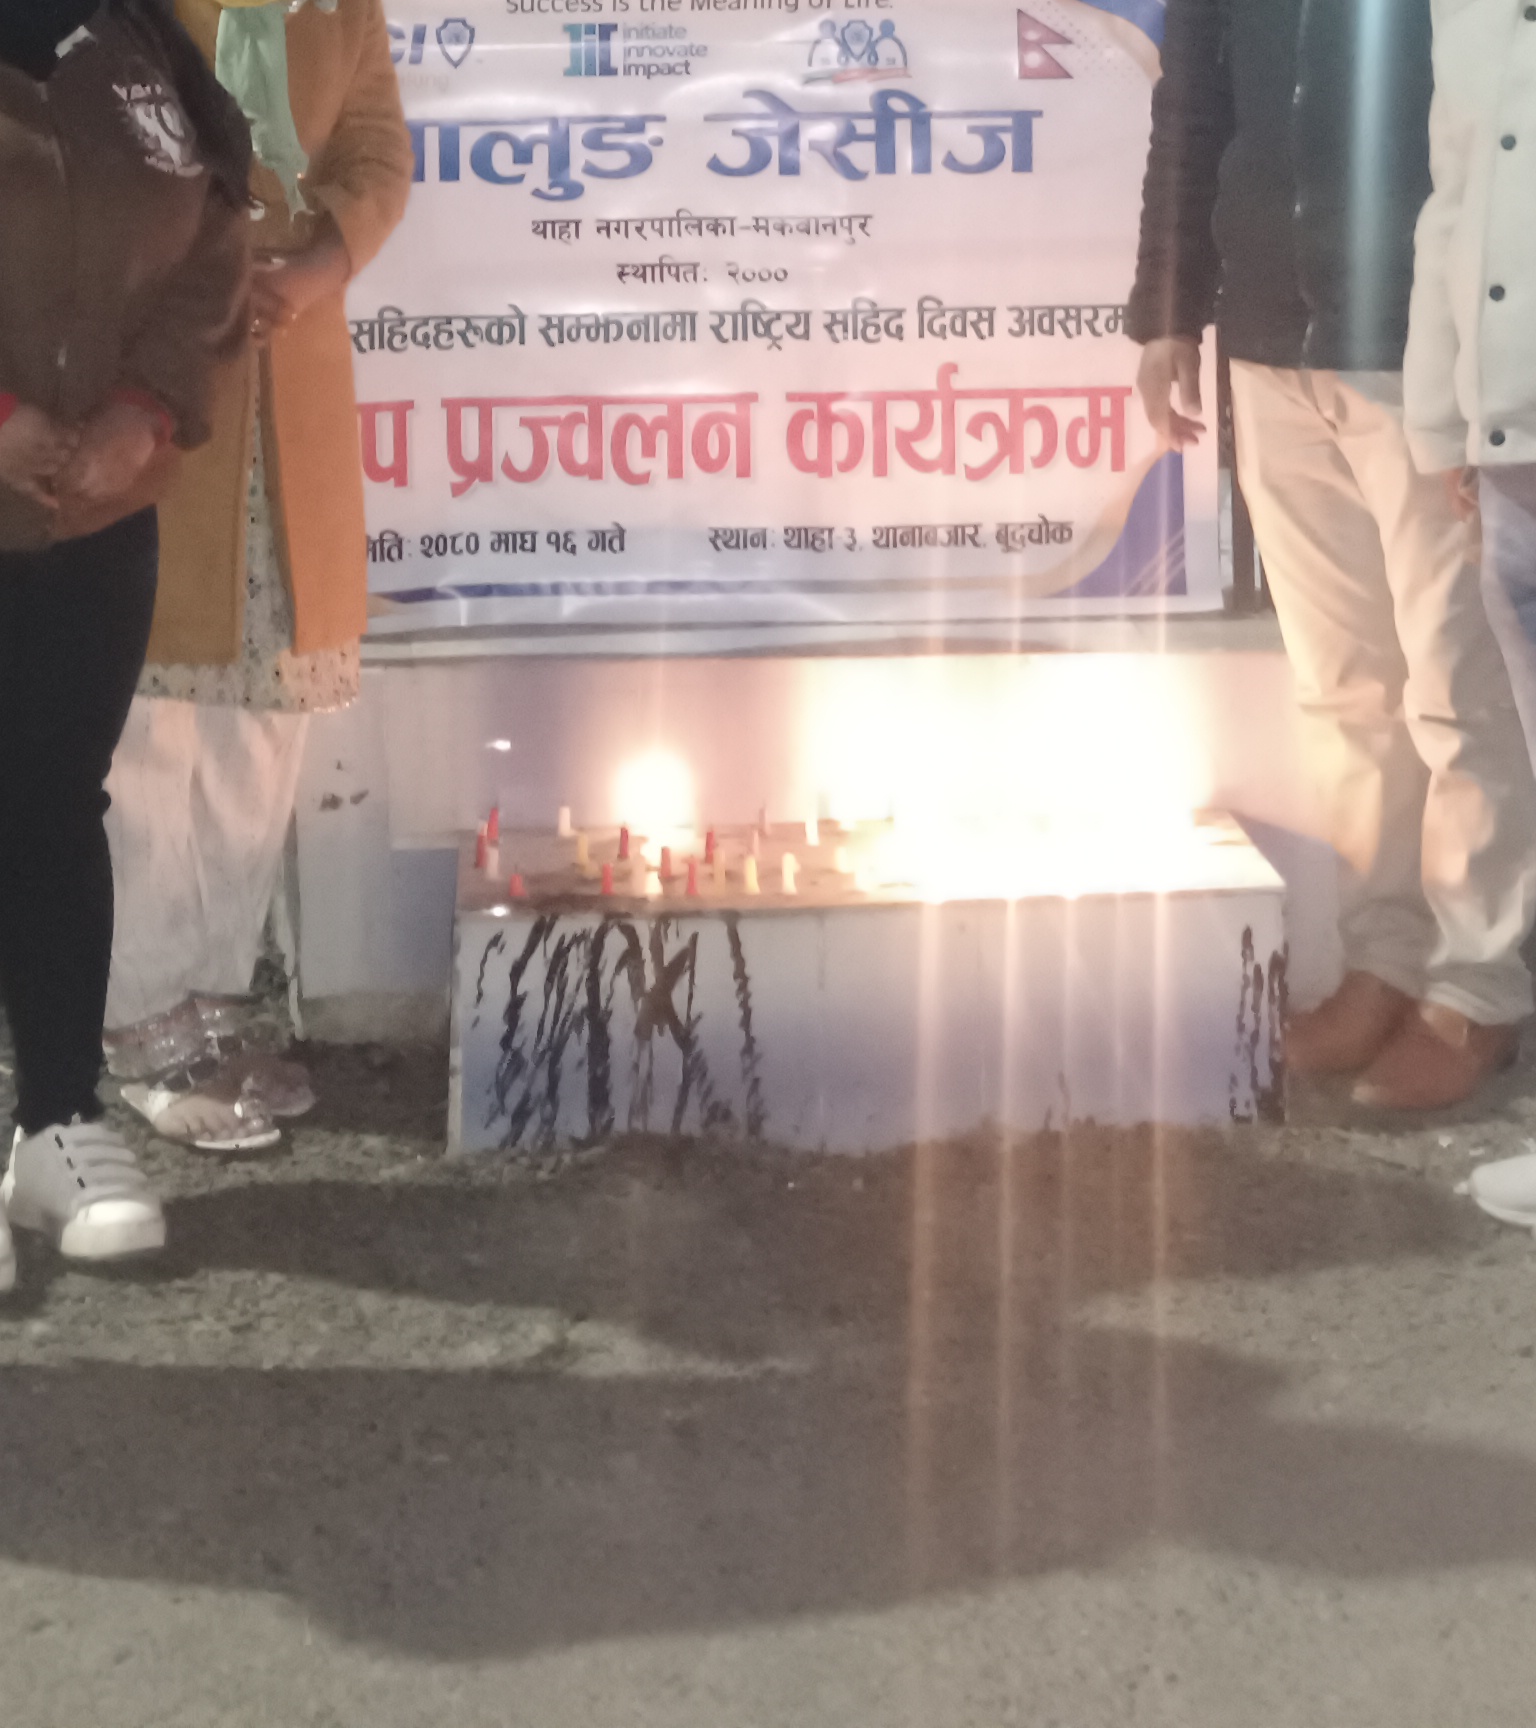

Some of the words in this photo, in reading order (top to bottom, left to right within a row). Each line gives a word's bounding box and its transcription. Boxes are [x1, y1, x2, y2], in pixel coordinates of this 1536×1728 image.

[623, 21, 688, 40] initiate
[623, 41, 709, 58] innovate
[623, 58, 692, 80] impact
[702, 87, 1044, 182] जेसीज
[530, 218, 584, 246] थाहा
[724, 261, 789, 286] २०००
[708, 297, 813, 352] राष्ट्रिय
[822, 296, 907, 344] सहिद
[916, 294, 997, 341] दिवस
[1006, 303, 1130, 341] अवसरम
[440, 391, 759, 499] प्रज्वलन
[784, 361, 1134, 483] कार्यक्रम
[419, 529, 481, 559] २०८०
[489, 528, 540, 555] माघ
[545, 529, 578, 557] १६
[585, 521, 628, 555] गते
